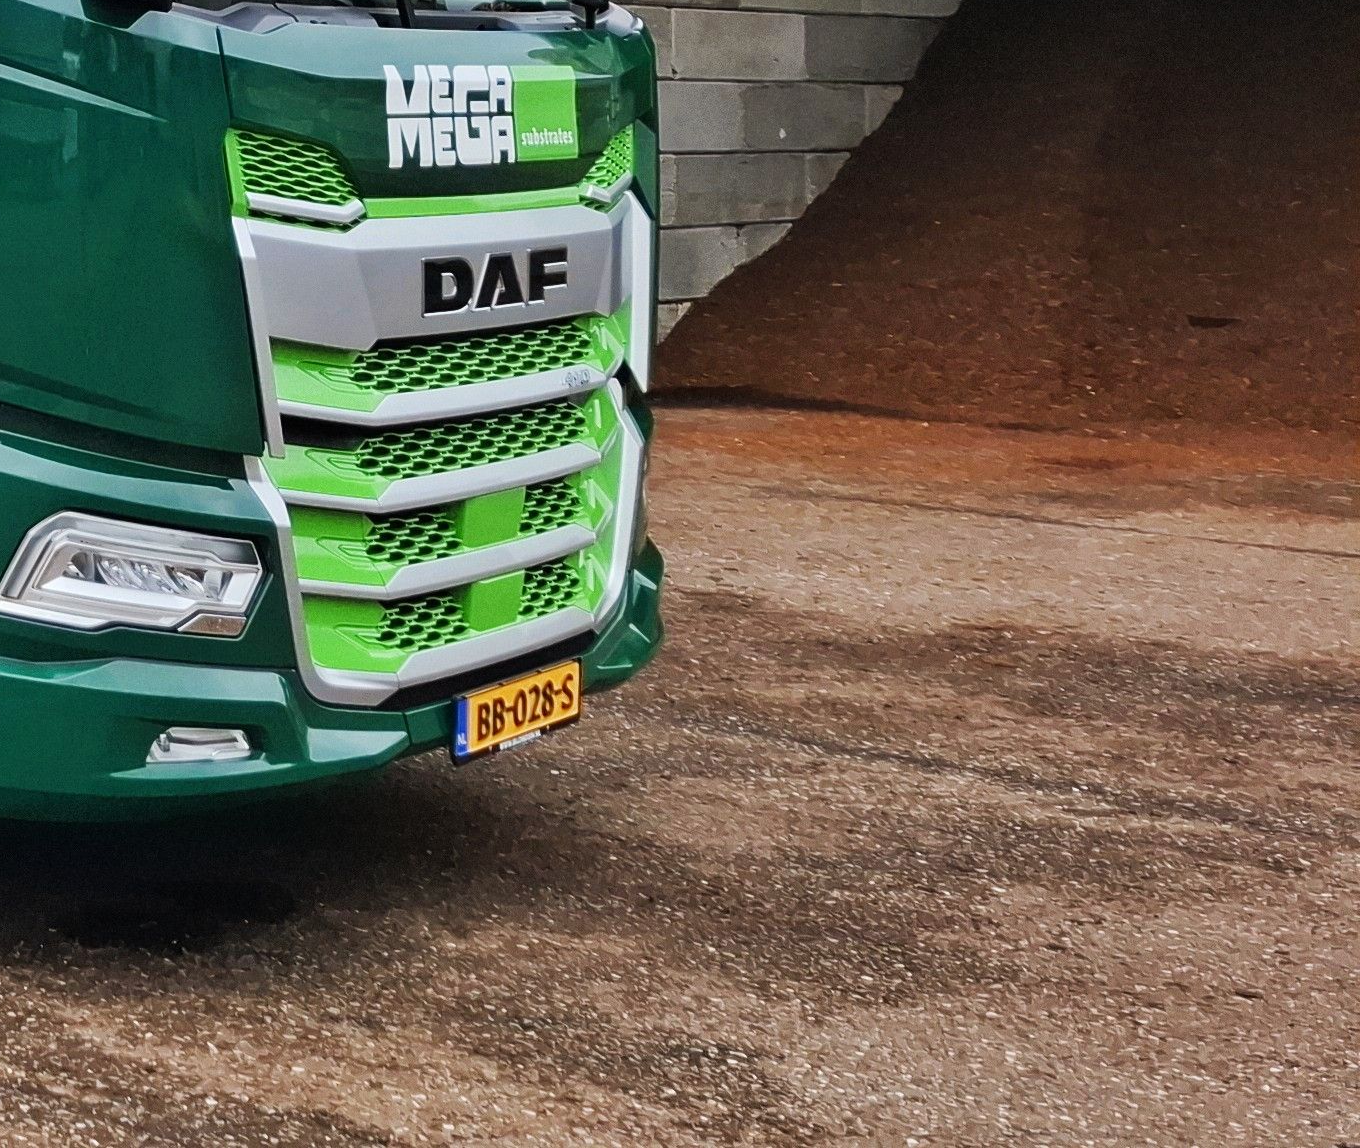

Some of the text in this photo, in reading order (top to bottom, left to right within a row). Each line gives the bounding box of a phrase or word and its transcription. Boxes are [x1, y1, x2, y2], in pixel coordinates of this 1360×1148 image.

[383, 65, 514, 116] MEGA
[387, 114, 516, 168] MEGA
[520, 128, 573, 147] substrates
[421, 247, 568, 319] DAF
[477, 673, 574, 741] BB-028-S
